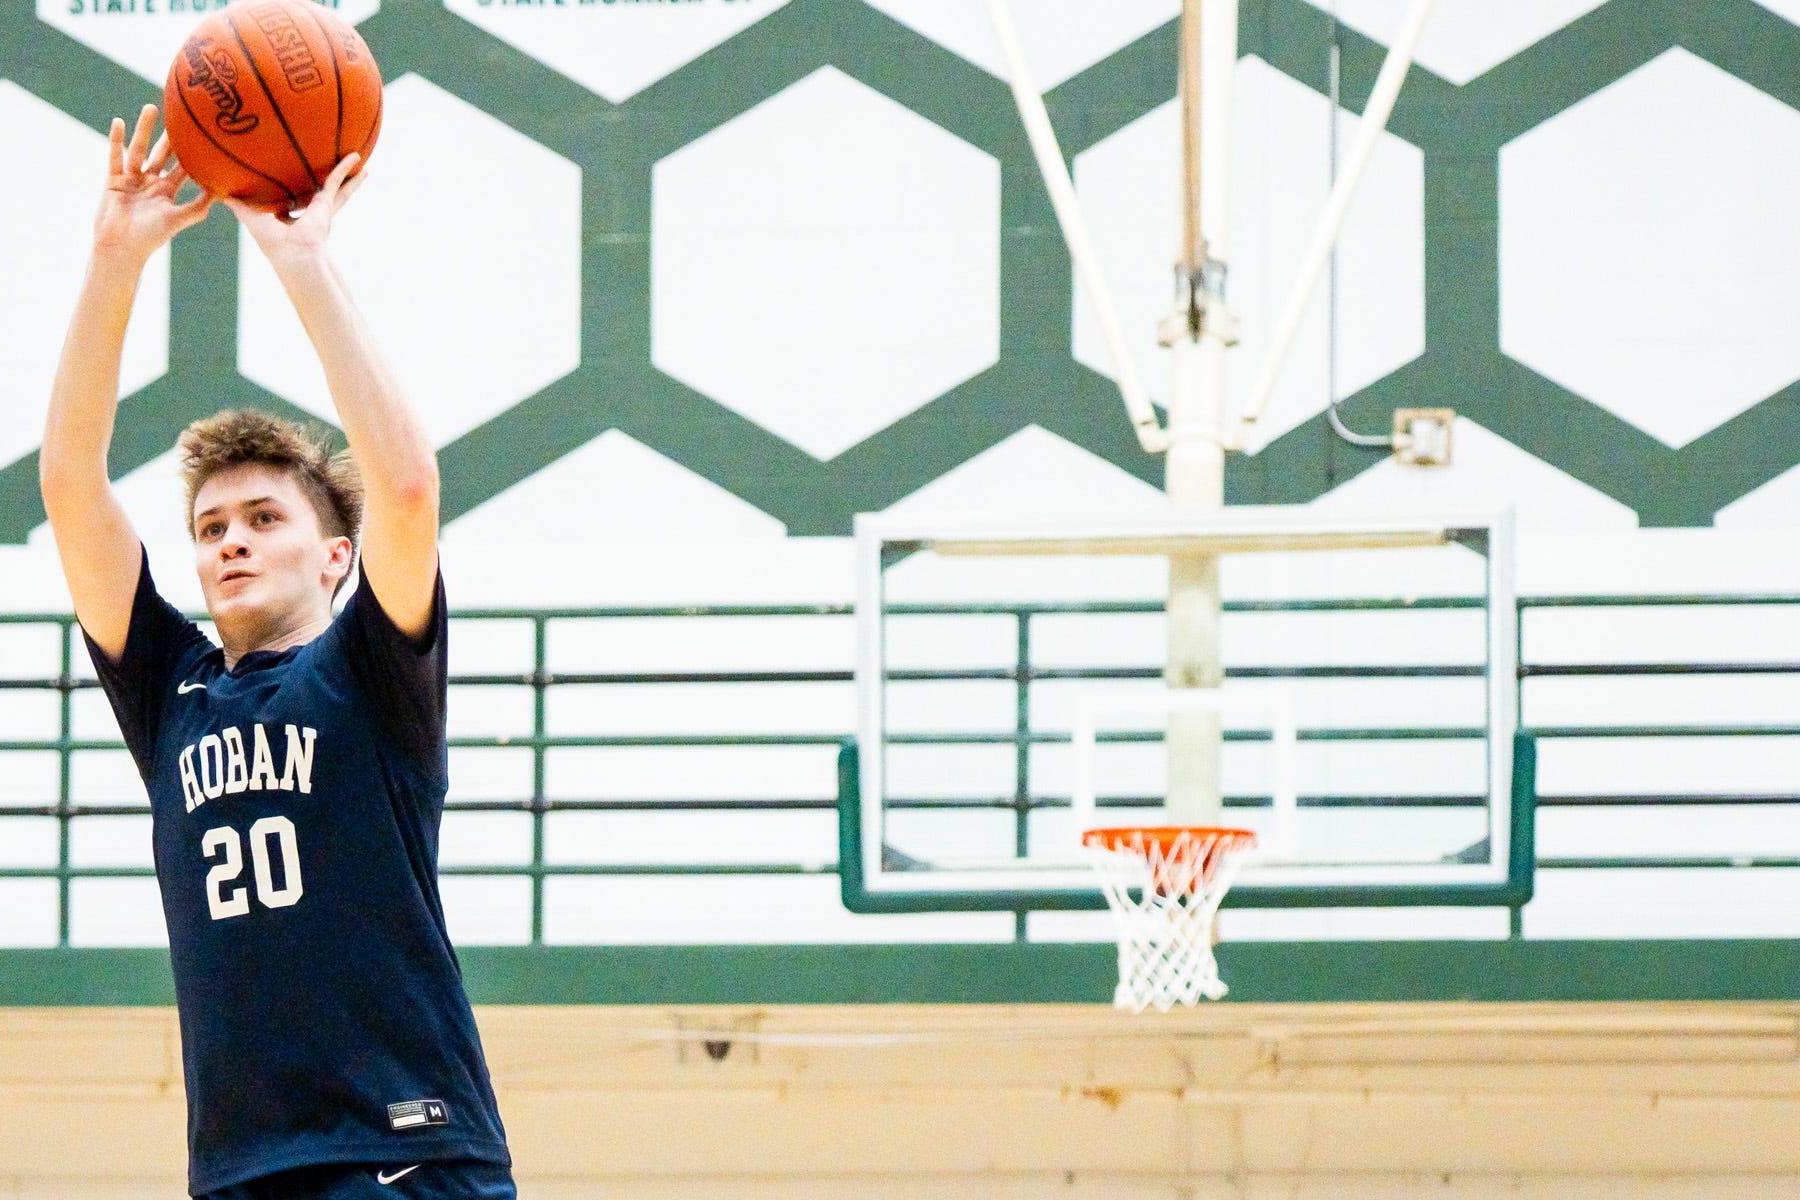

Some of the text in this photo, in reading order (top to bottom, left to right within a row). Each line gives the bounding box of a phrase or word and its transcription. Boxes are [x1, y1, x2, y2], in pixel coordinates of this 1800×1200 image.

[179, 722, 318, 814] HOBAN
[201, 815, 304, 921] 20
[429, 1105, 442, 1117] M
